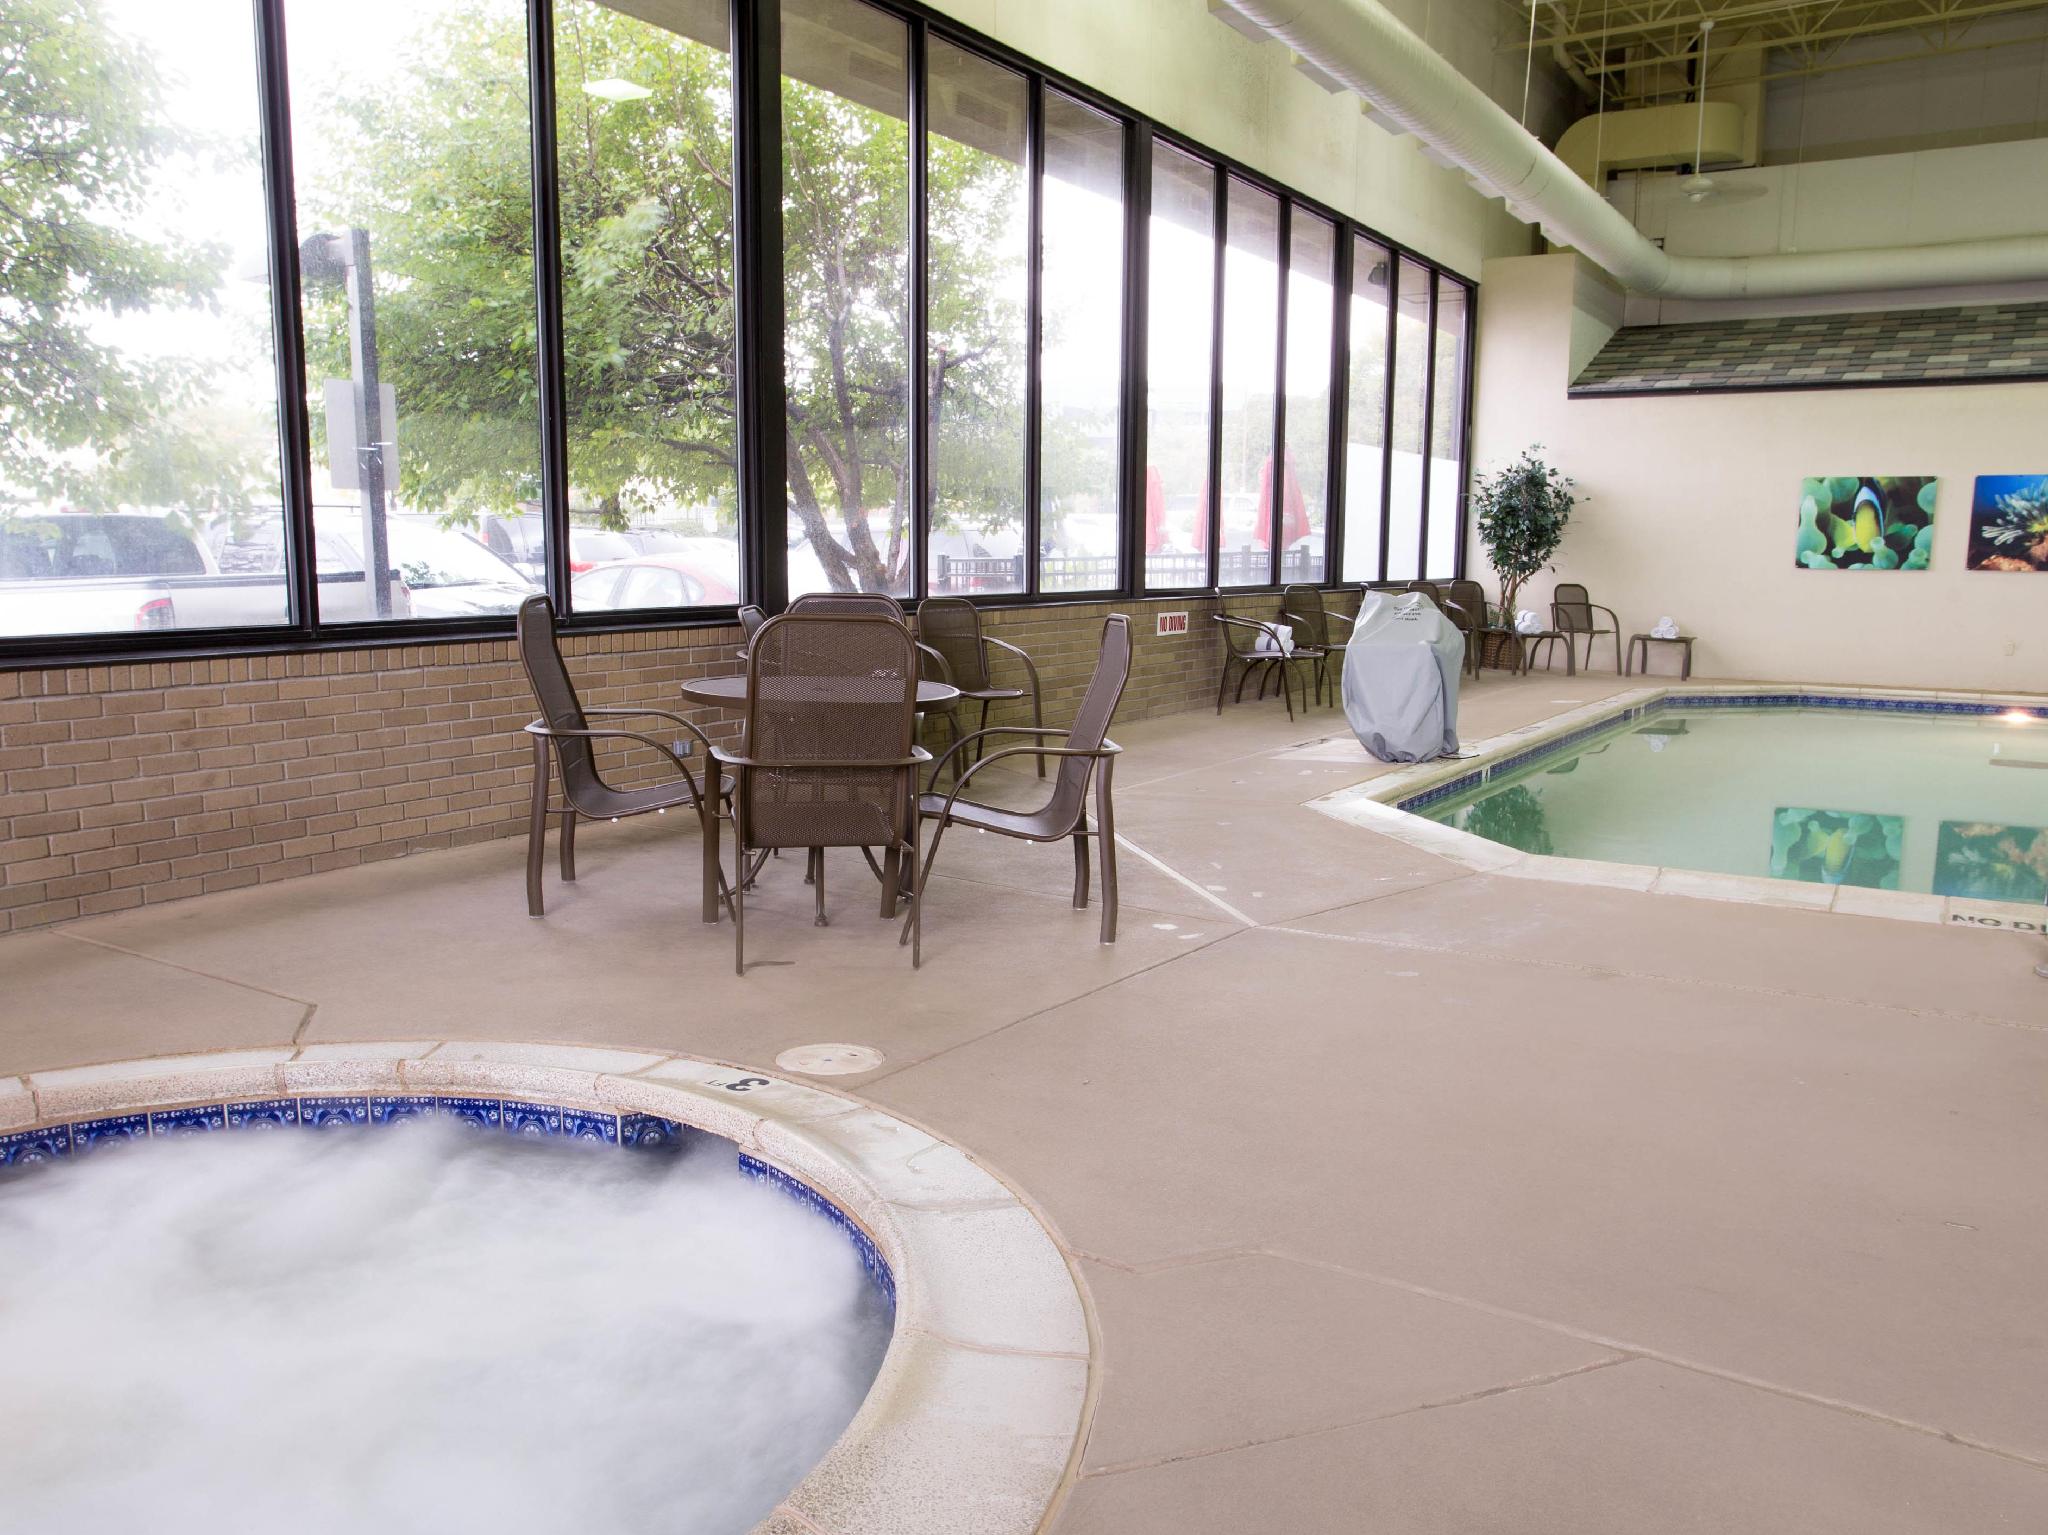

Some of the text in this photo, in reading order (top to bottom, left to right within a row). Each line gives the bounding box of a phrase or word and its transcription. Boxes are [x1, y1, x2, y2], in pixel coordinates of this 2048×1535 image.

[1160, 614, 1186, 632] NO DIVING
[1952, 914, 2002, 927] NO
[725, 1078, 770, 1091] 3
